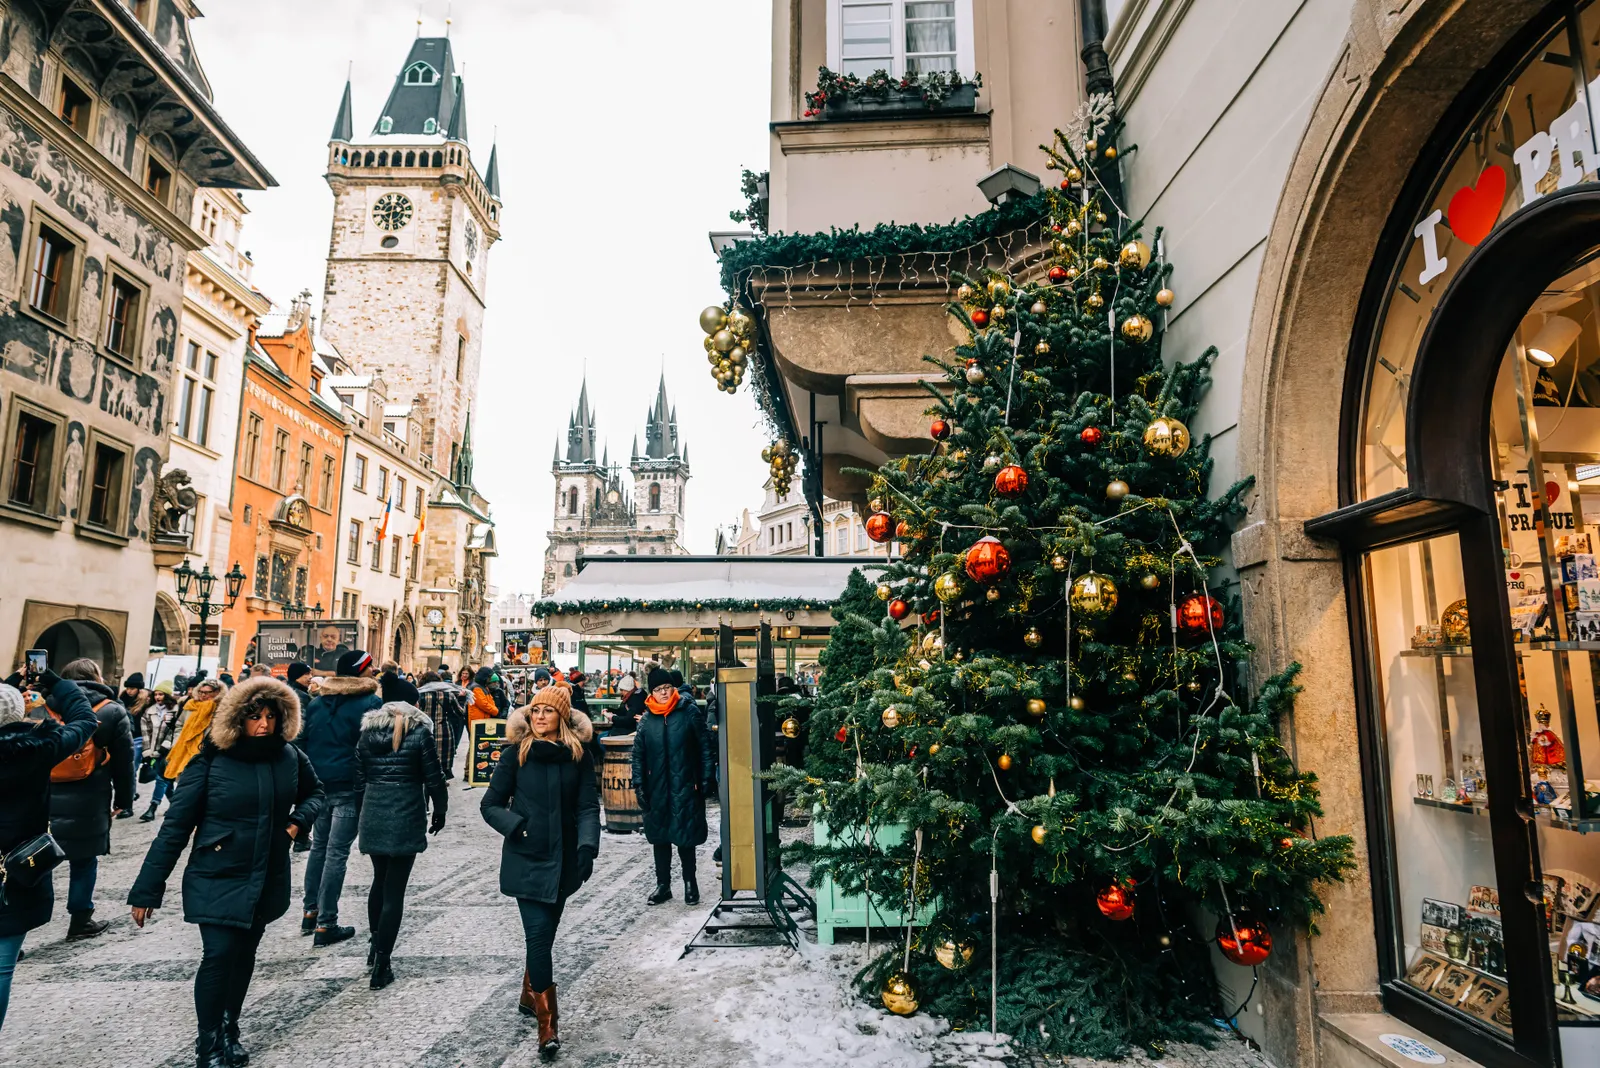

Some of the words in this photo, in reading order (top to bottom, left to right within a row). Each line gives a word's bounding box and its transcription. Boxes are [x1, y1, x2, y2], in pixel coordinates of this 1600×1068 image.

[1512, 483, 1531, 508] I
[268, 643, 287, 651] food
[267, 650, 297, 659] quality
